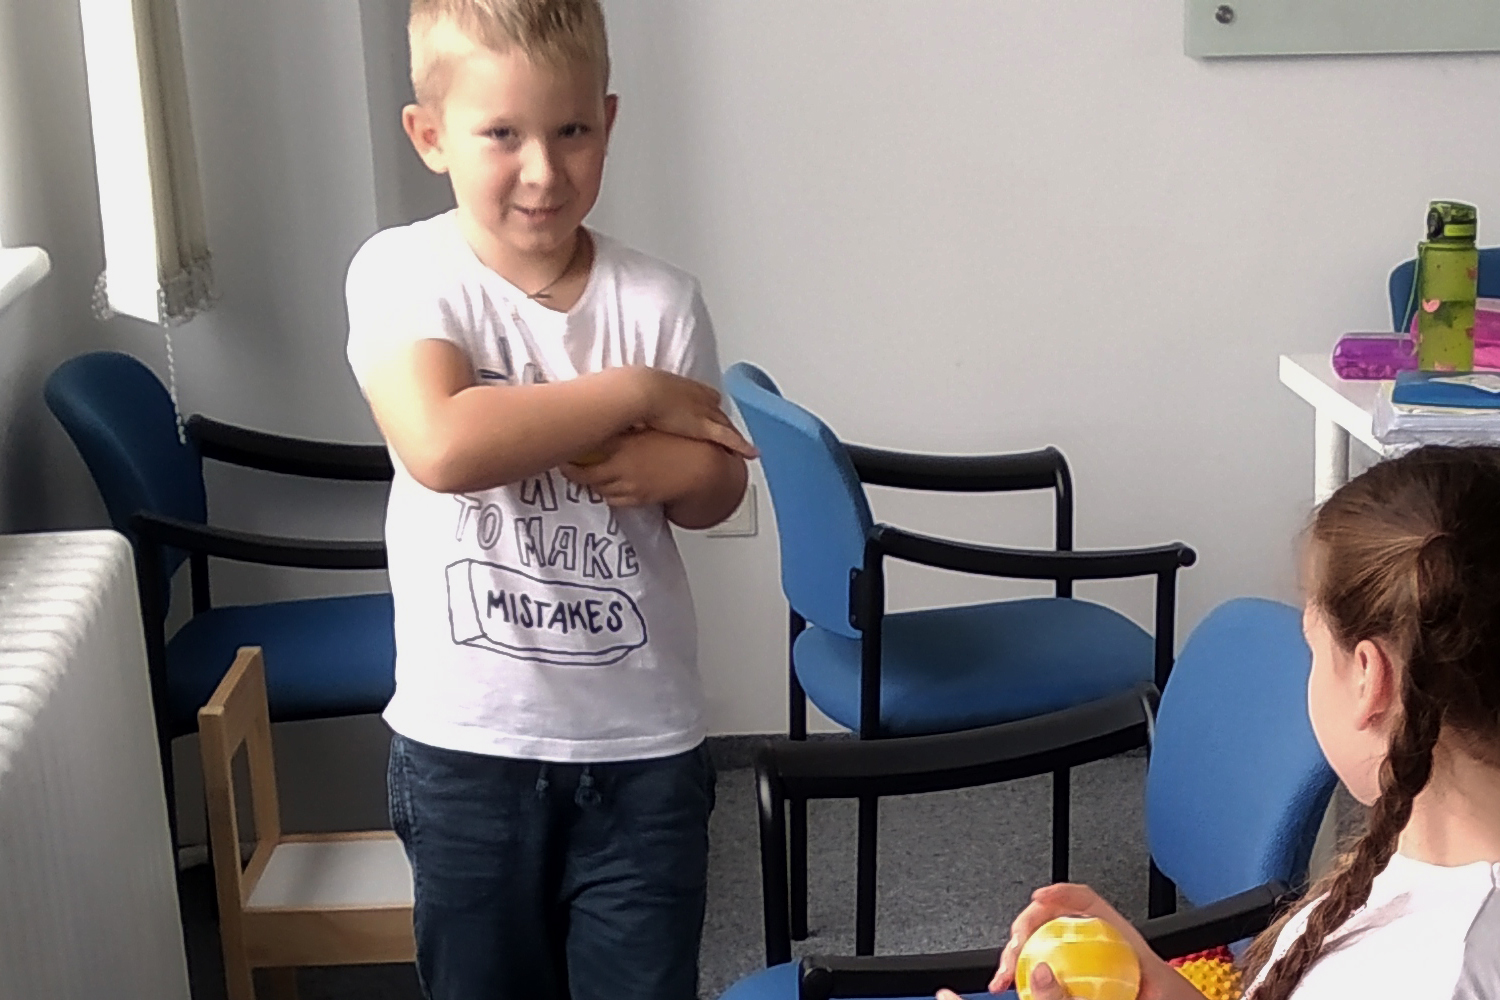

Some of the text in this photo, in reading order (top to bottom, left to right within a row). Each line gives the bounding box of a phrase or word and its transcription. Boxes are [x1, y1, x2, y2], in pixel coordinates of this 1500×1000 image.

[453, 494, 503, 550] TO
[514, 516, 639, 579] MAKE
[487, 590, 622, 633] MISTAKES
